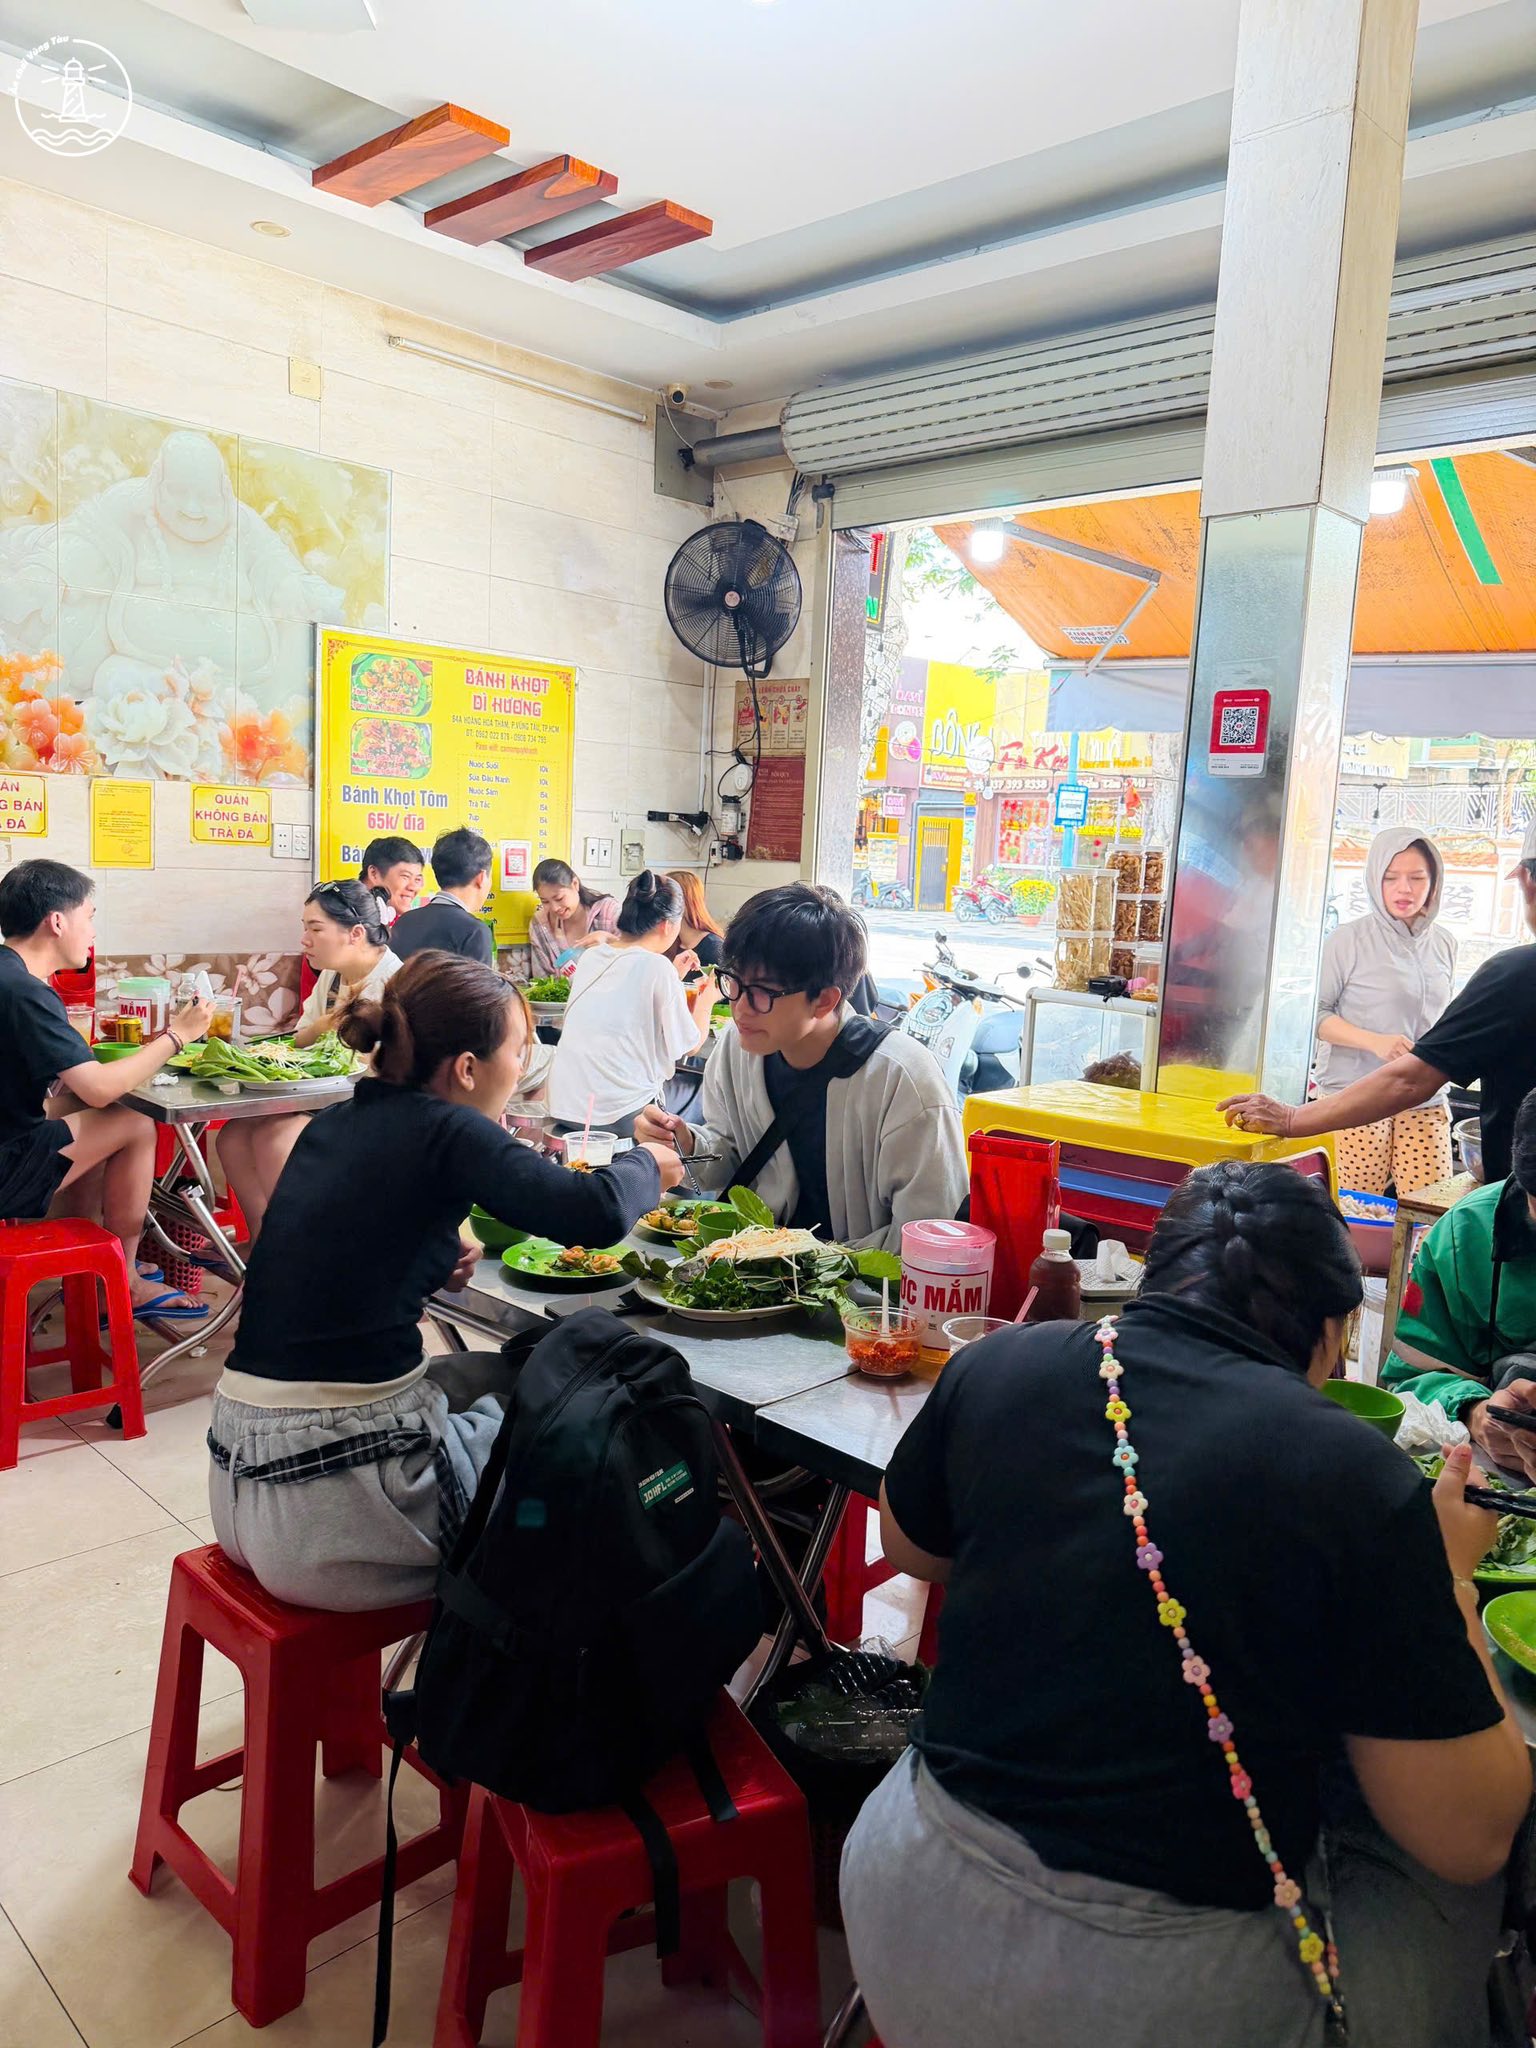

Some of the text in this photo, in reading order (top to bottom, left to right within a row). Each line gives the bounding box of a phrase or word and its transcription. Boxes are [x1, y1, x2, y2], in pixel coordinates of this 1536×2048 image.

[465, 666, 550, 696] BÁNH KHỌT
[473, 693, 541, 717] DÌ HƯƠNG
[13, 798, 43, 812] BÁN
[214, 793, 249, 806] QUÁN
[342, 785, 448, 810] Bánh Khọt Tôm
[7, 817, 26, 830] ĐÁ
[195, 809, 268, 824] KHÔNG BÁN
[367, 812, 425, 831] 65k/ đĩa
[209, 825, 255, 840] TRÀ ĐÁ
[120, 1001, 147, 1018] MẮM
[924, 1279, 983, 1313] MẮM
